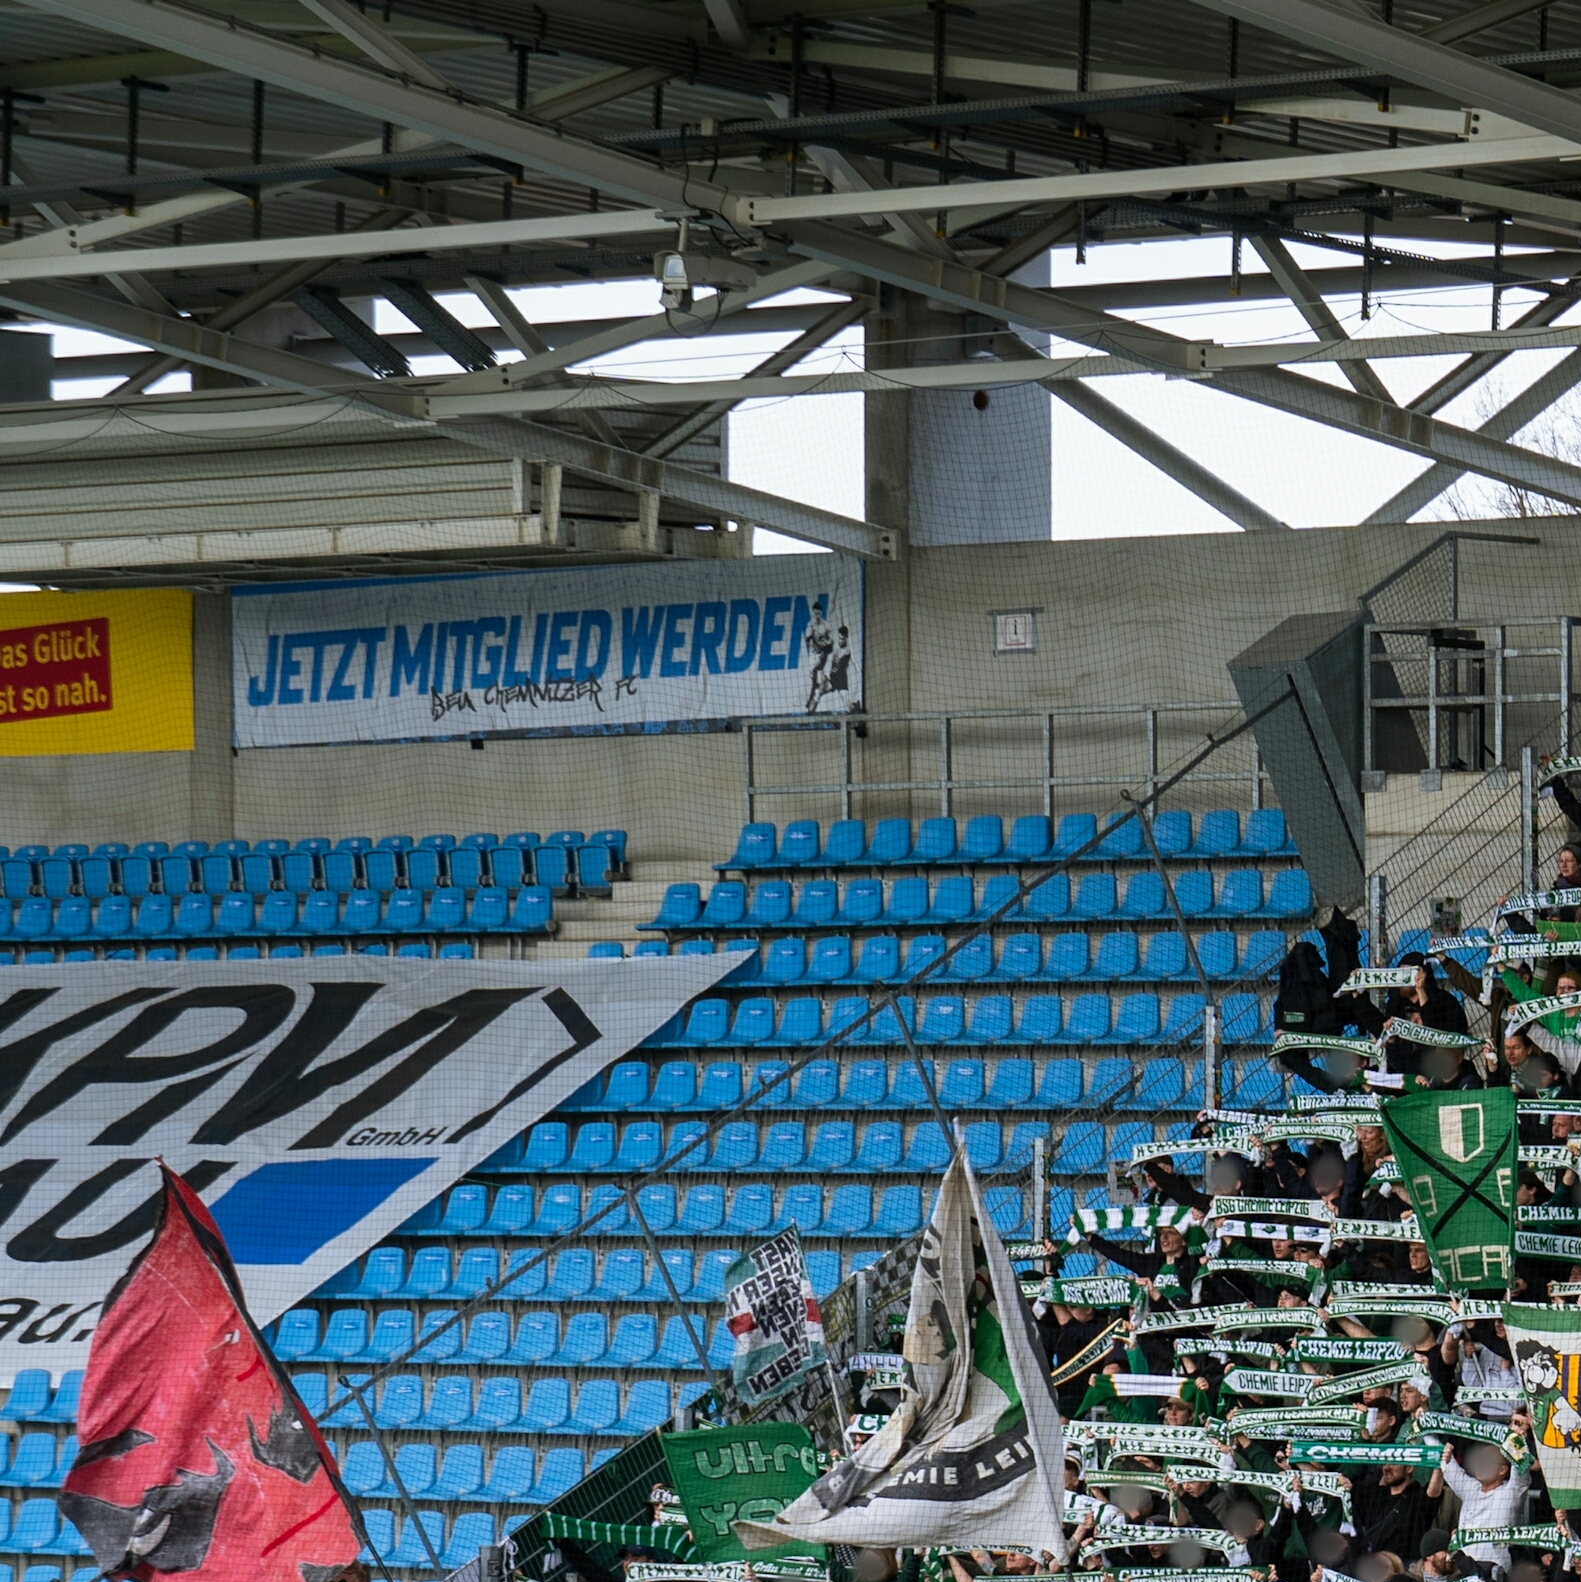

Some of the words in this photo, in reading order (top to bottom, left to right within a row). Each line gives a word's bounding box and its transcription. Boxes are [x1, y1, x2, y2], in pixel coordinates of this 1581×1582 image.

[34, 627, 101, 663] Glück
[247, 627, 385, 706] JETZT
[399, 610, 609, 696] MITGLIED
[620, 593, 830, 677] WERDEN
[22, 686, 49, 711] so
[56, 672, 107, 706] nah.
[346, 1126, 449, 1147] GmbH
